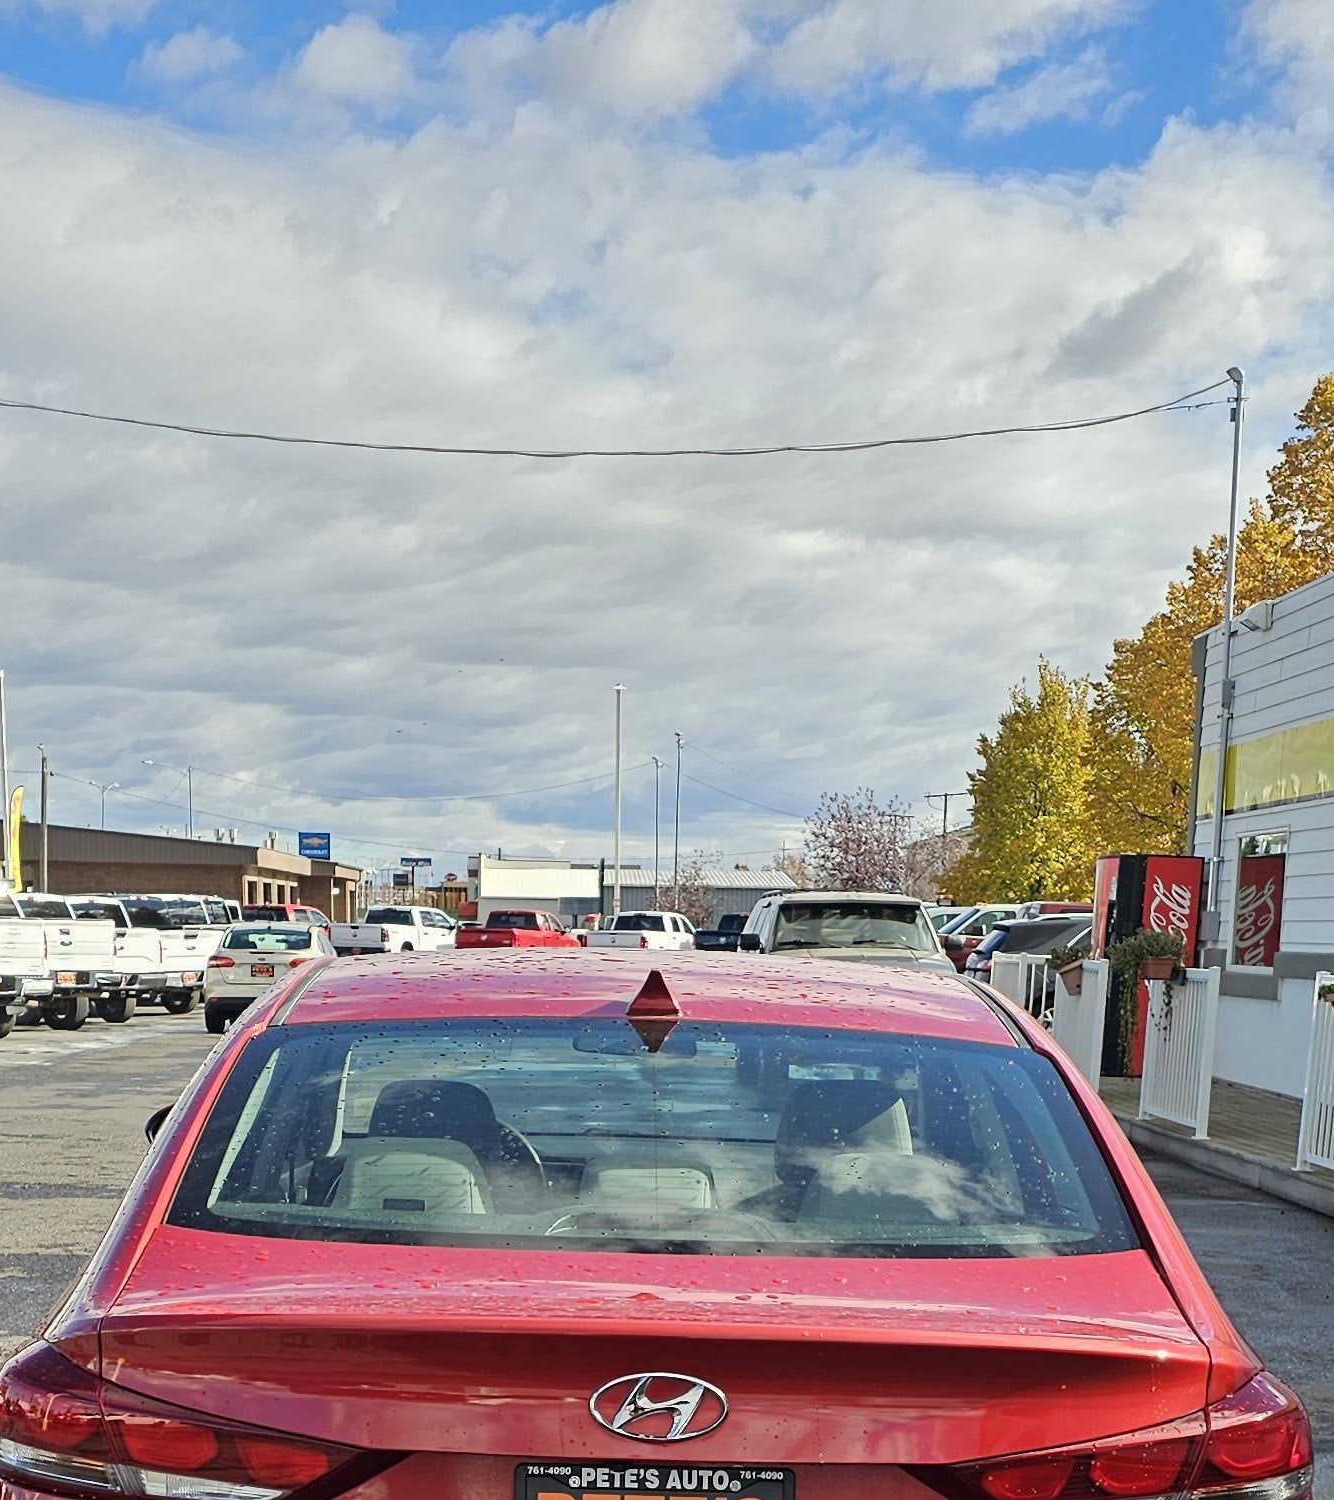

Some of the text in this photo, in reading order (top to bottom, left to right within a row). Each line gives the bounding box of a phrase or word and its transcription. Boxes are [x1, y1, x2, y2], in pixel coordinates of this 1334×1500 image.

[527, 1466, 784, 1491] 761-4090 PETE'S AUTO 761-4090
